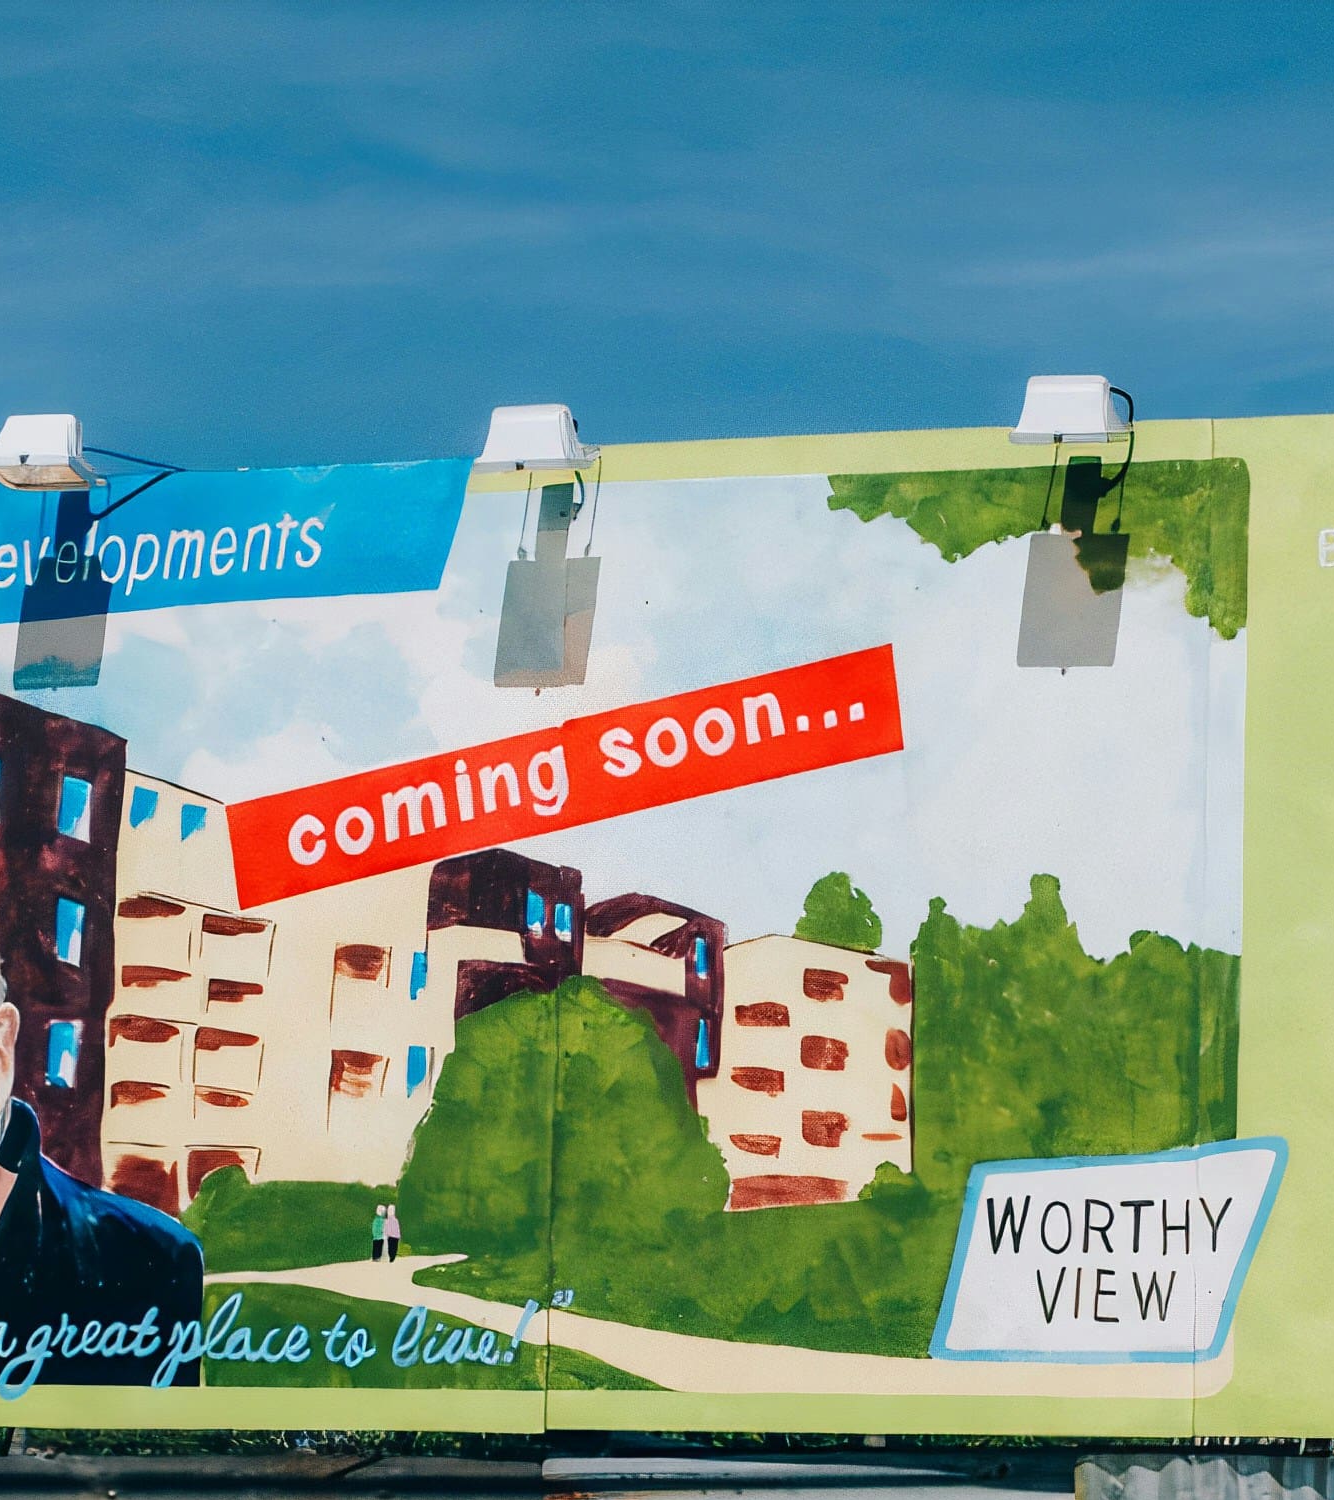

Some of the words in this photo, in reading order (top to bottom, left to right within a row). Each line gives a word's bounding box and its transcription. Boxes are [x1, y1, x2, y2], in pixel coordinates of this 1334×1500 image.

[287, 744, 567, 866] coming
[598, 691, 865, 777] soon...
[987, 1196, 1232, 1256] WORTHY
[1036, 1268, 1177, 1323] VIEW
[150, 1292, 310, 1388] place
[322, 1313, 376, 1367] to
